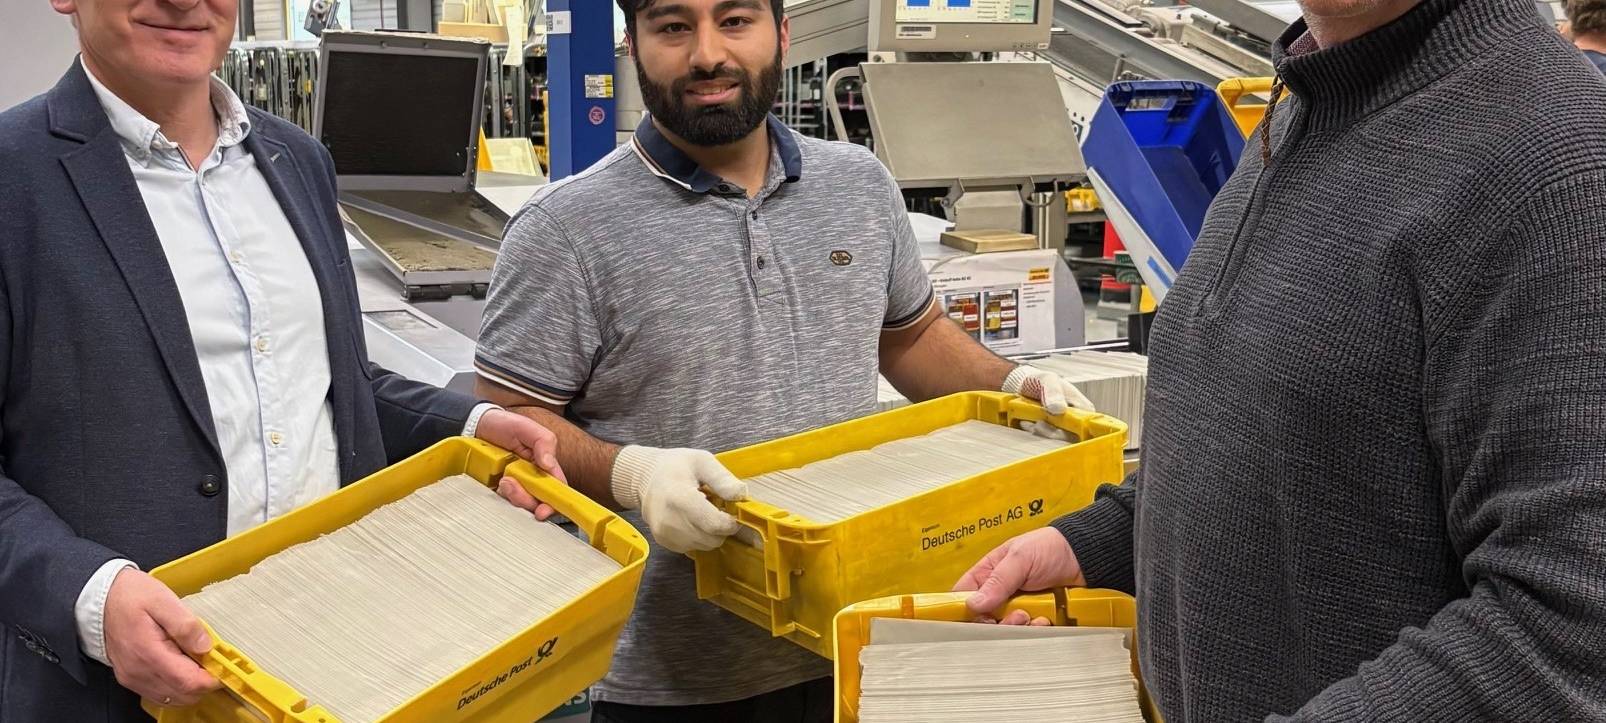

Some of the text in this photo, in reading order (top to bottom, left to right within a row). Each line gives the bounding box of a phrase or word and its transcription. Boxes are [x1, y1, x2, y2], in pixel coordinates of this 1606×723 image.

[922, 523, 976, 551] Deutsche
[978, 513, 1003, 531] Post
[1006, 506, 1024, 522] AG
[456, 672, 508, 711] Deutsche
[509, 656, 533, 680] Post
